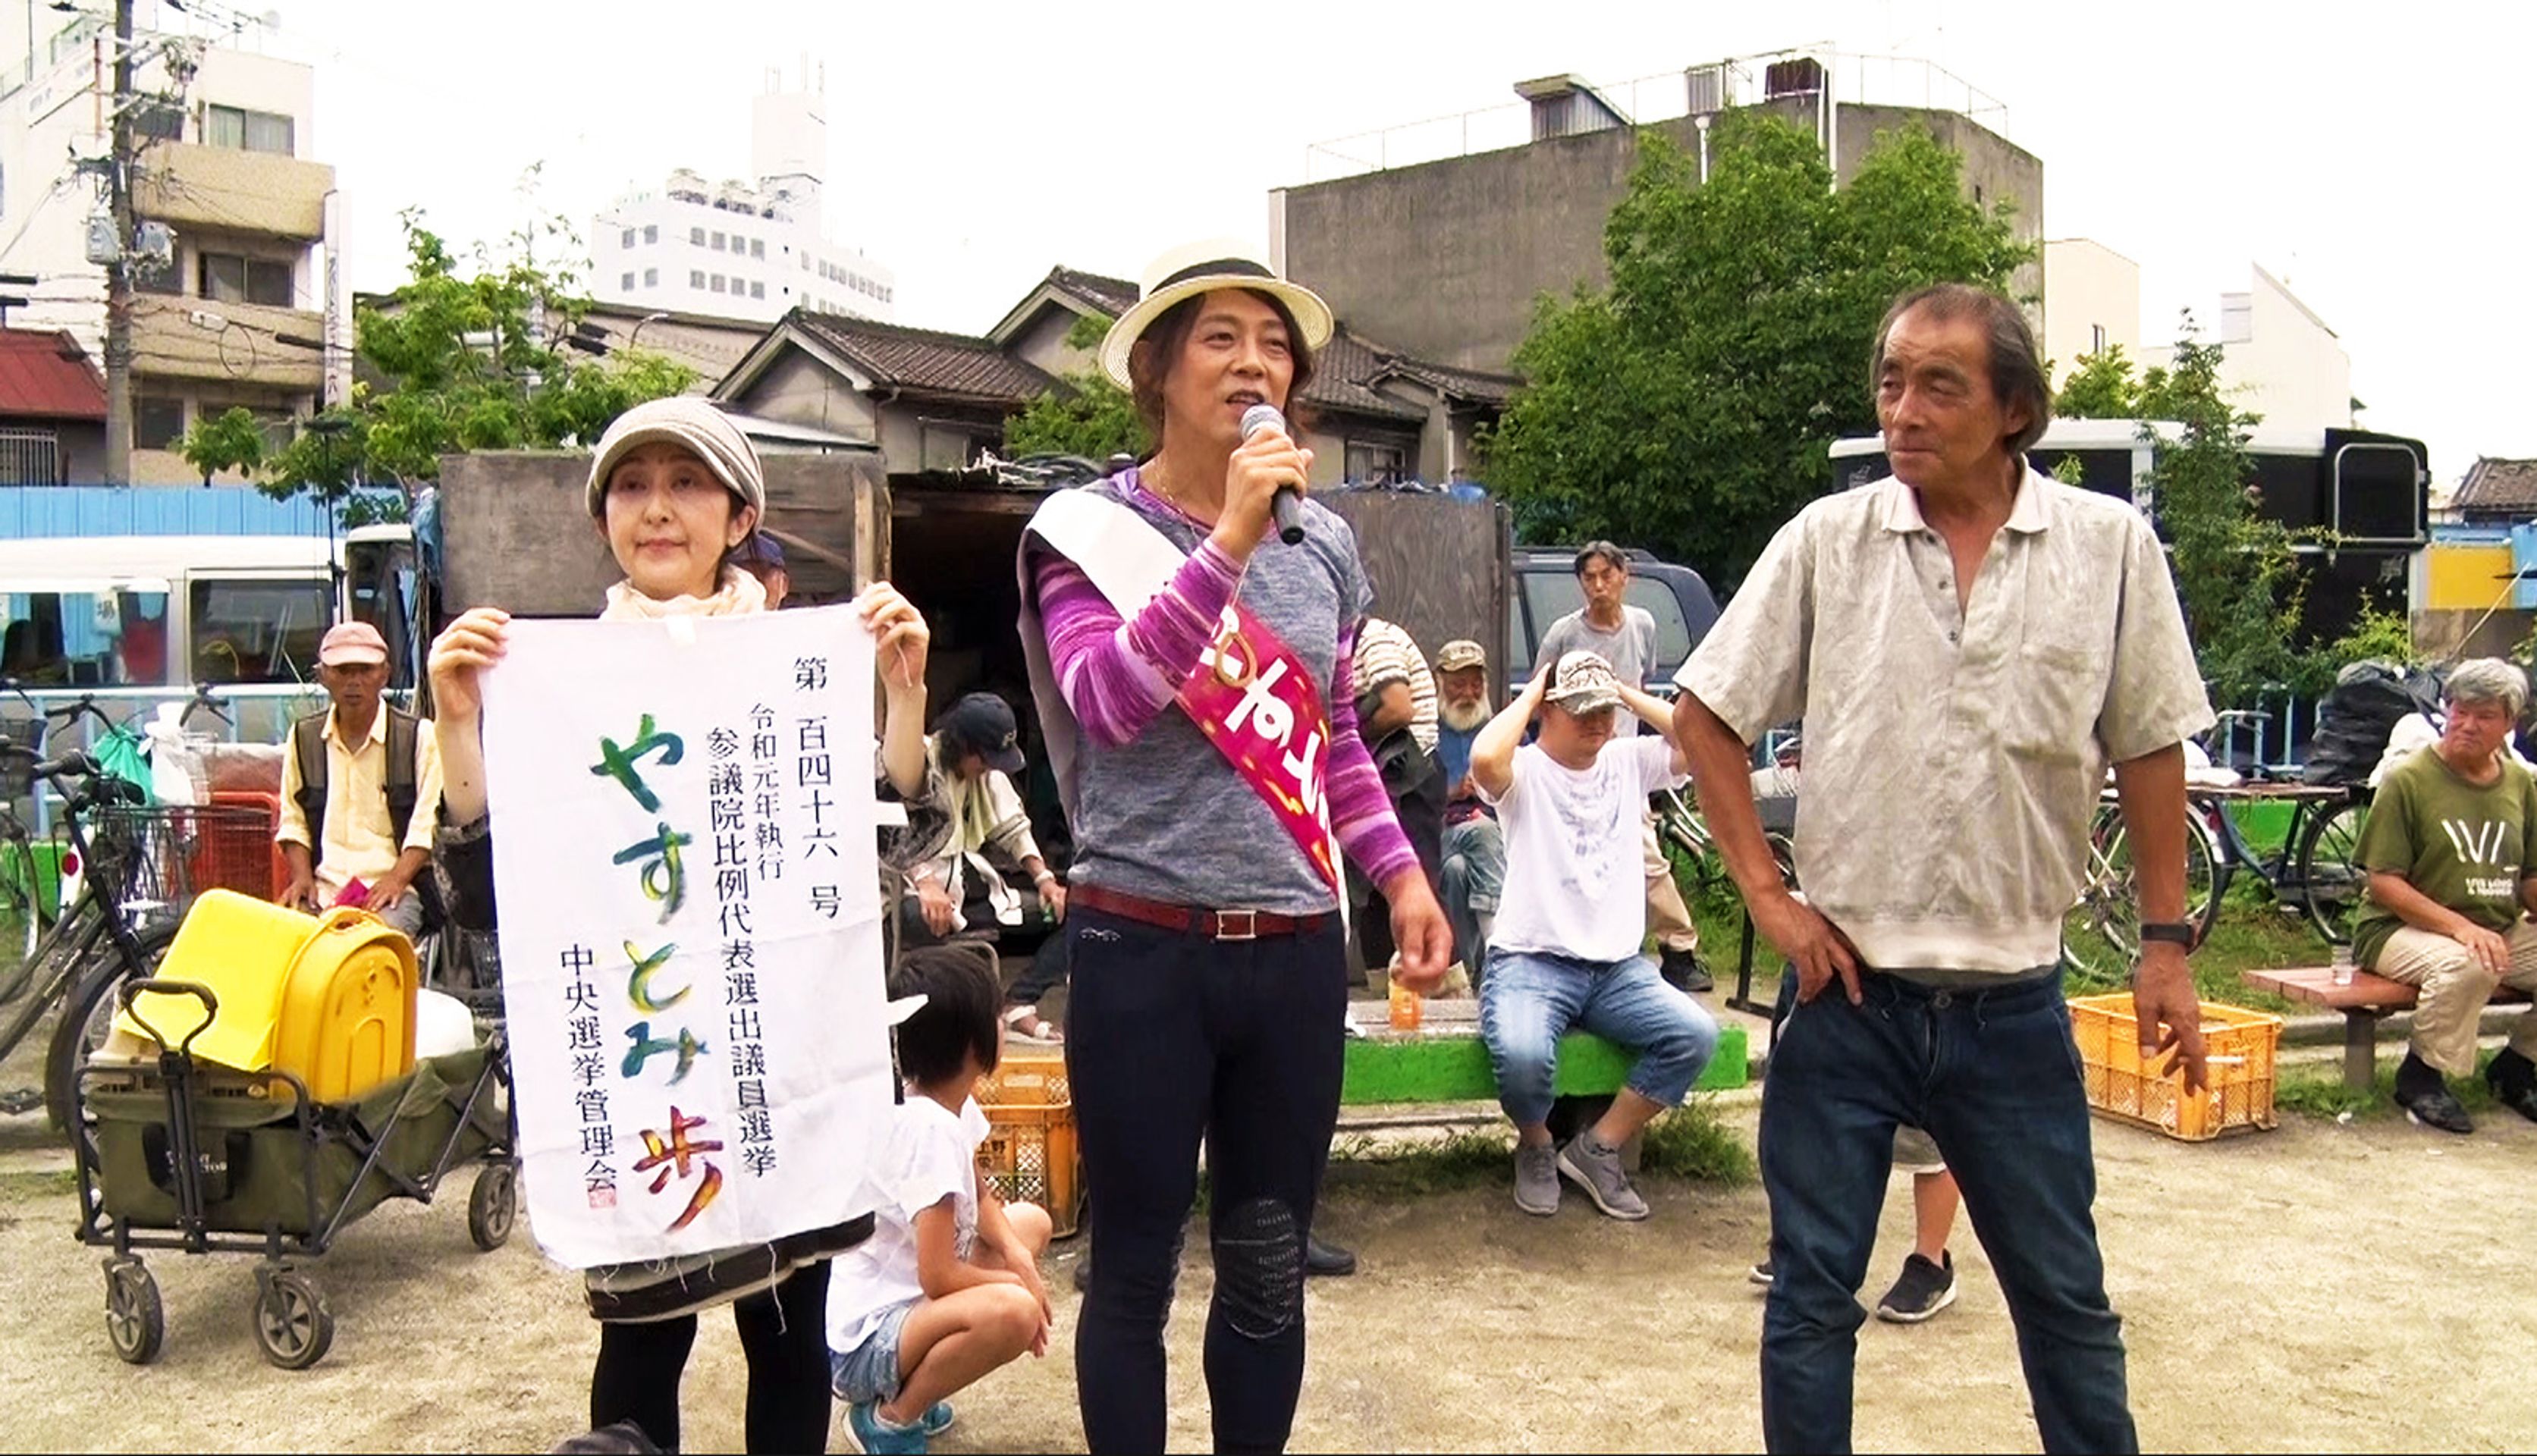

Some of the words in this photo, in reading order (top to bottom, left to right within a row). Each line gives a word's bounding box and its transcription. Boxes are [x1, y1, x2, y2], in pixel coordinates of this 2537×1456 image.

[750, 702, 784, 881] 令和元年執行
[560, 943, 617, 1193] 中央選挙管理会
[706, 726, 777, 1179] 参議院比例代表選出議員選挙
